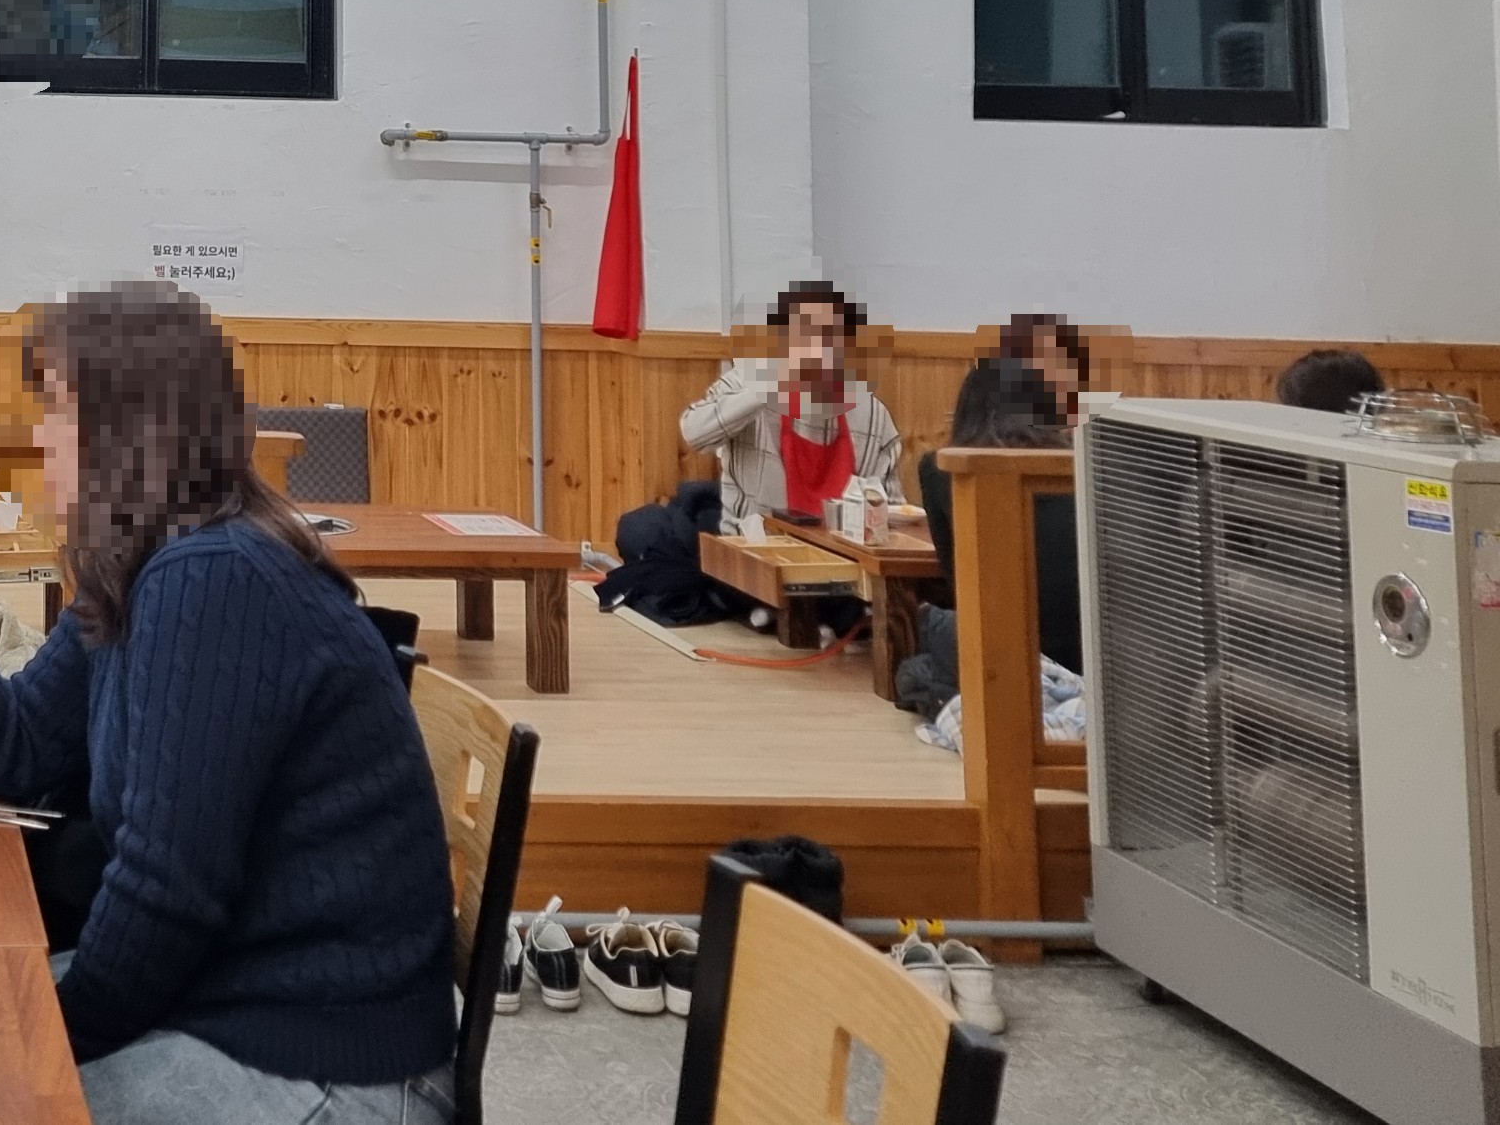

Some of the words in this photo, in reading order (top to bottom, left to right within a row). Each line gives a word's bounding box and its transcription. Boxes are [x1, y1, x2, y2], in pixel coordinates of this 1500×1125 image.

[152, 245, 182, 256] 필요한
[185, 245, 195, 257] 게
[198, 246, 238, 258] 있으시면
[154, 265, 166, 278] 벨
[169, 265, 236, 281] 눌러주세요;)
